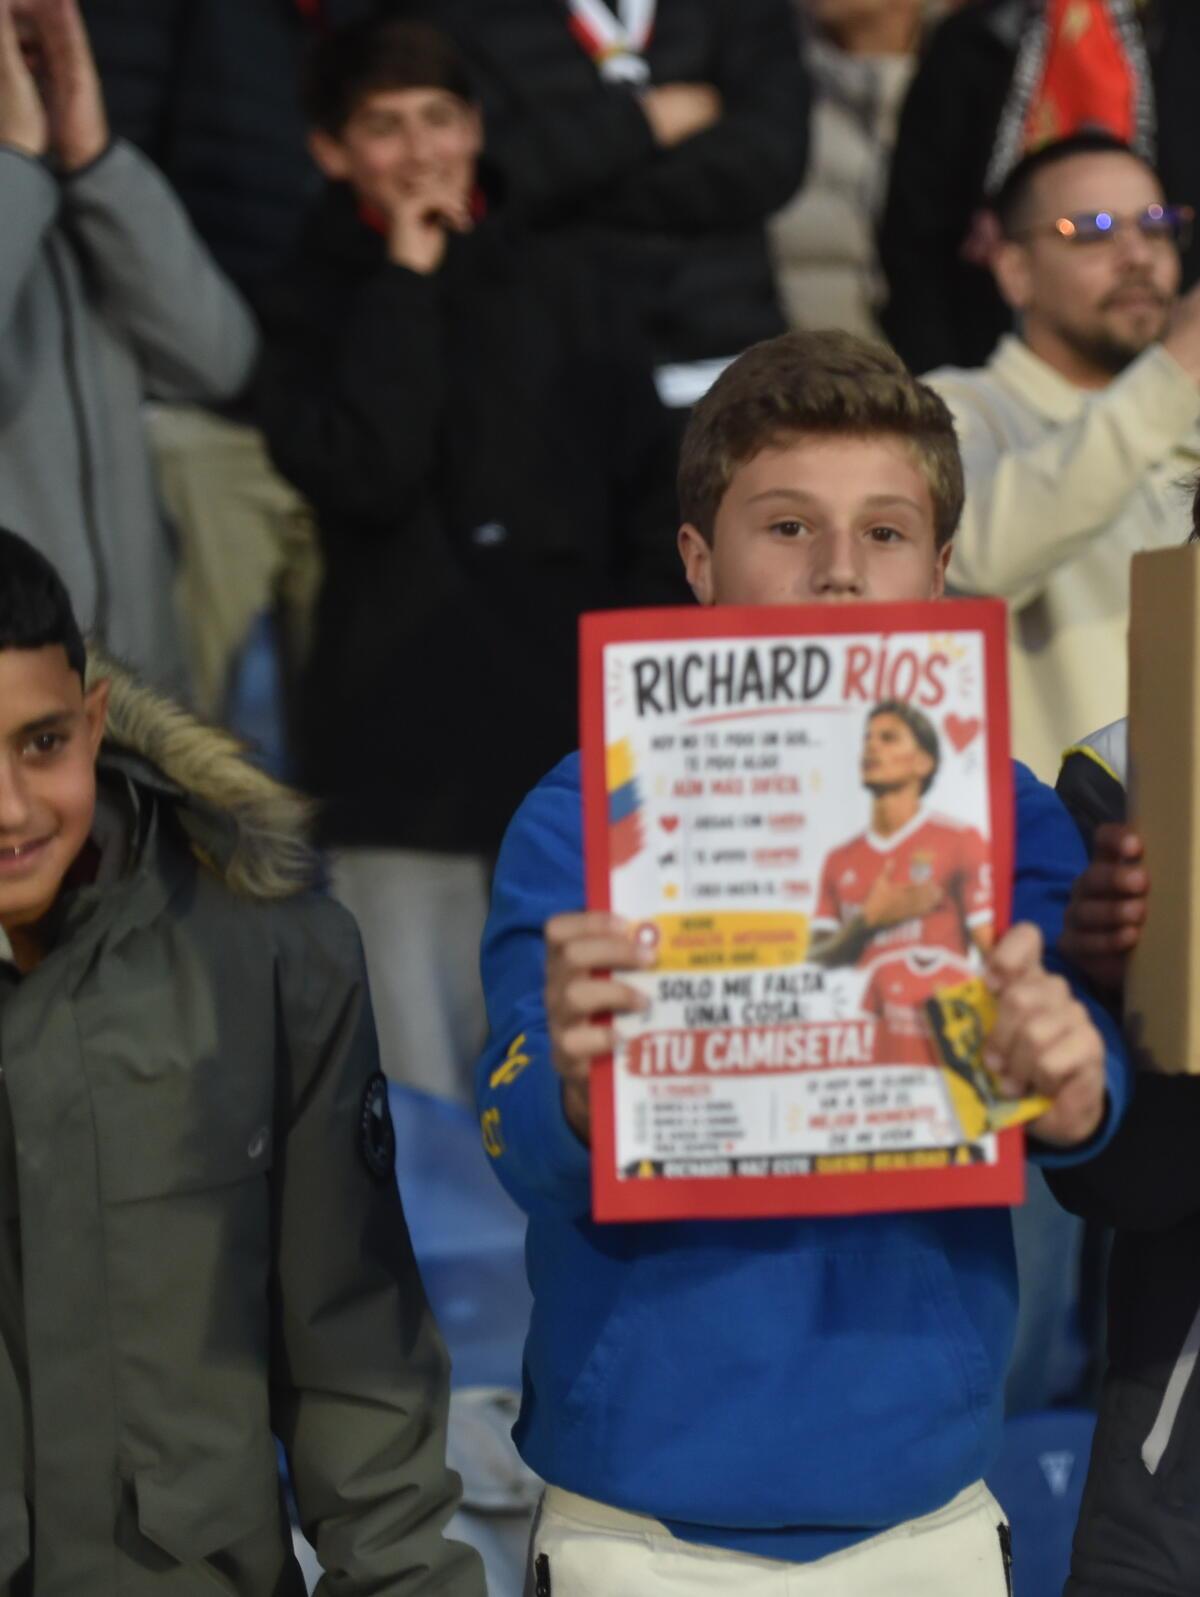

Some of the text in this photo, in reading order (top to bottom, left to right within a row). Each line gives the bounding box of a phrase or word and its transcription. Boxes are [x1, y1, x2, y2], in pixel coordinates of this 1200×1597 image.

[632, 633, 949, 718] RICHARD RÍOS
[658, 972, 825, 1001] SOLO ME FALTA
[685, 1004, 729, 1027] UNA
[640, 1021, 875, 1075] ¡TU CAMISETA!
